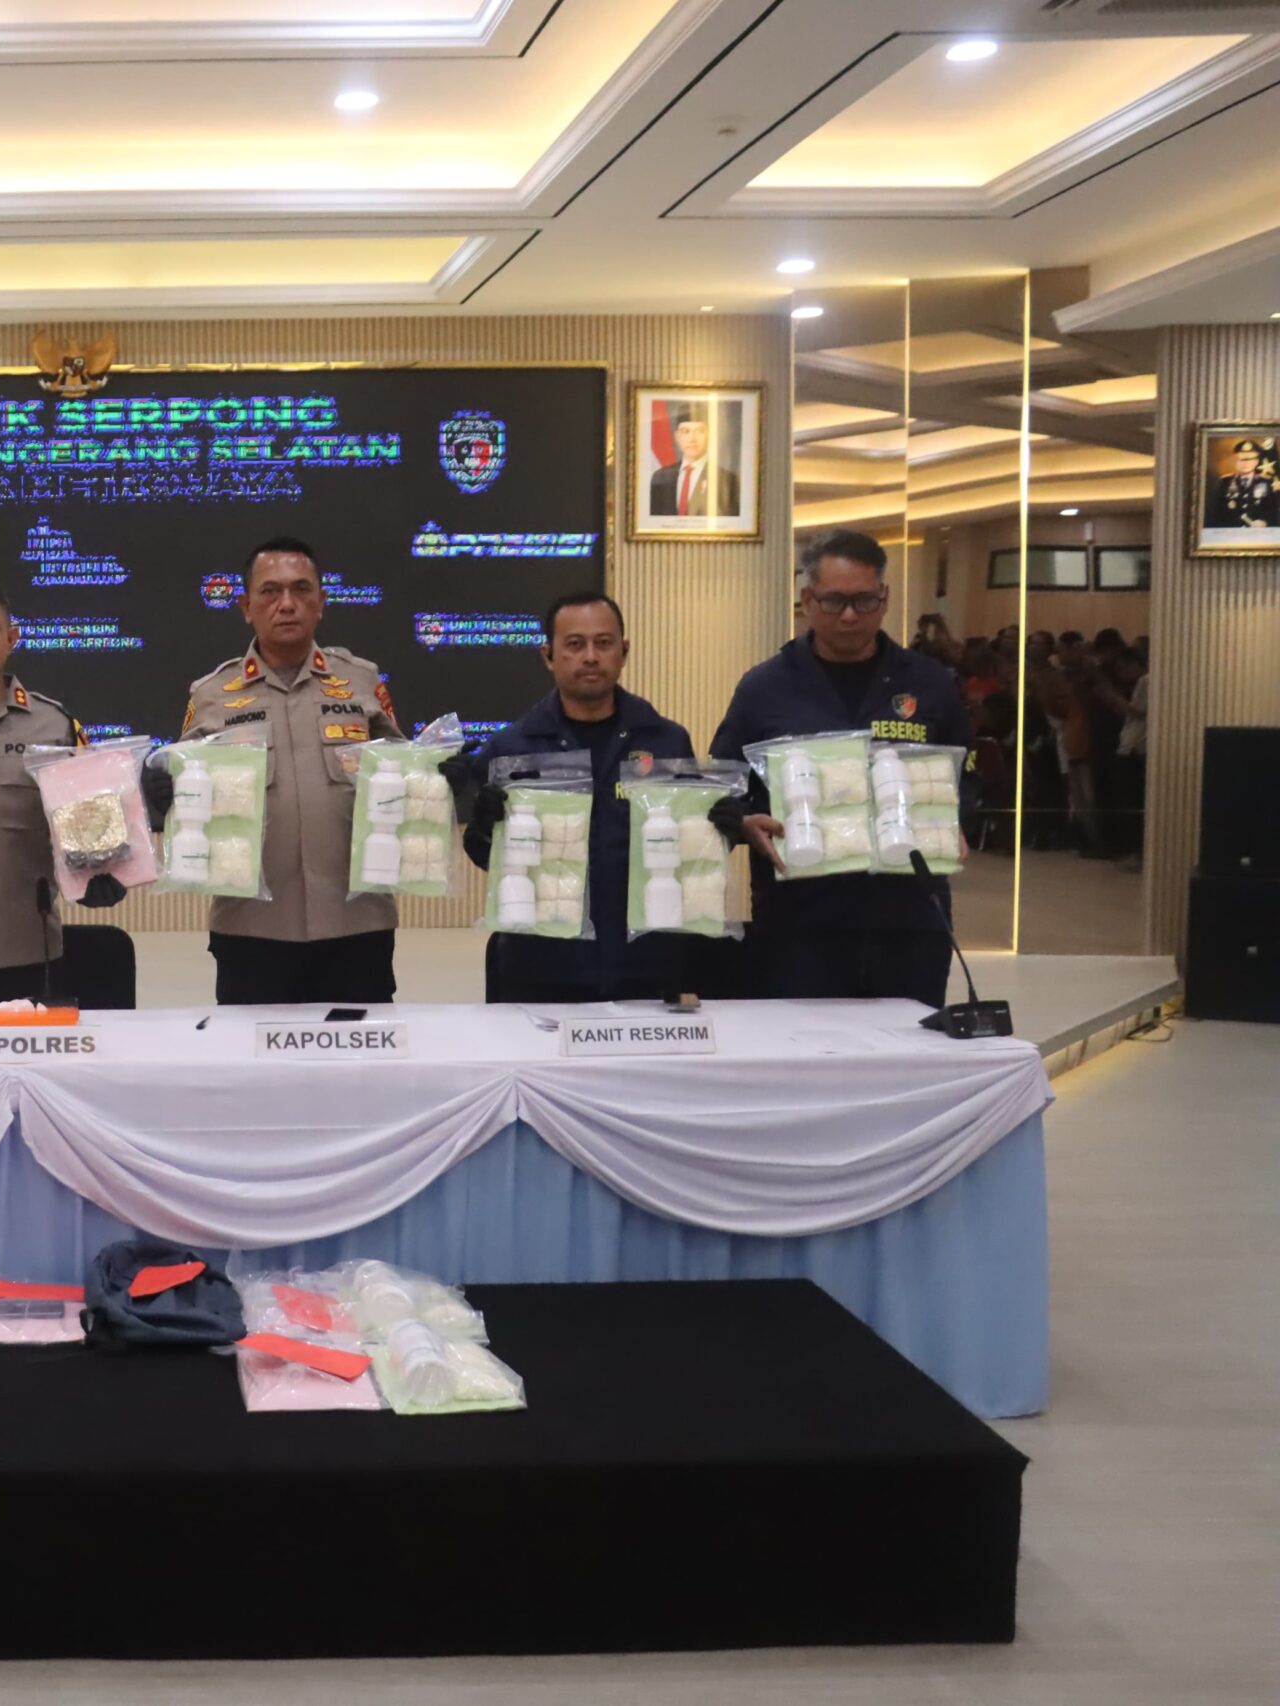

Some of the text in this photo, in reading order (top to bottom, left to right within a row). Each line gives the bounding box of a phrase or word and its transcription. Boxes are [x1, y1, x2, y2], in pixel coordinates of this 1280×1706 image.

[55, 397, 338, 432] SERPONG
[209, 434, 400, 466] SELATAN
[320, 703, 365, 715] POLRI
[870, 719, 928, 743] RESERSE
[266, 1031, 397, 1049] KAPOLSEK
[571, 1026, 709, 1043] KANIT RESKRIM
